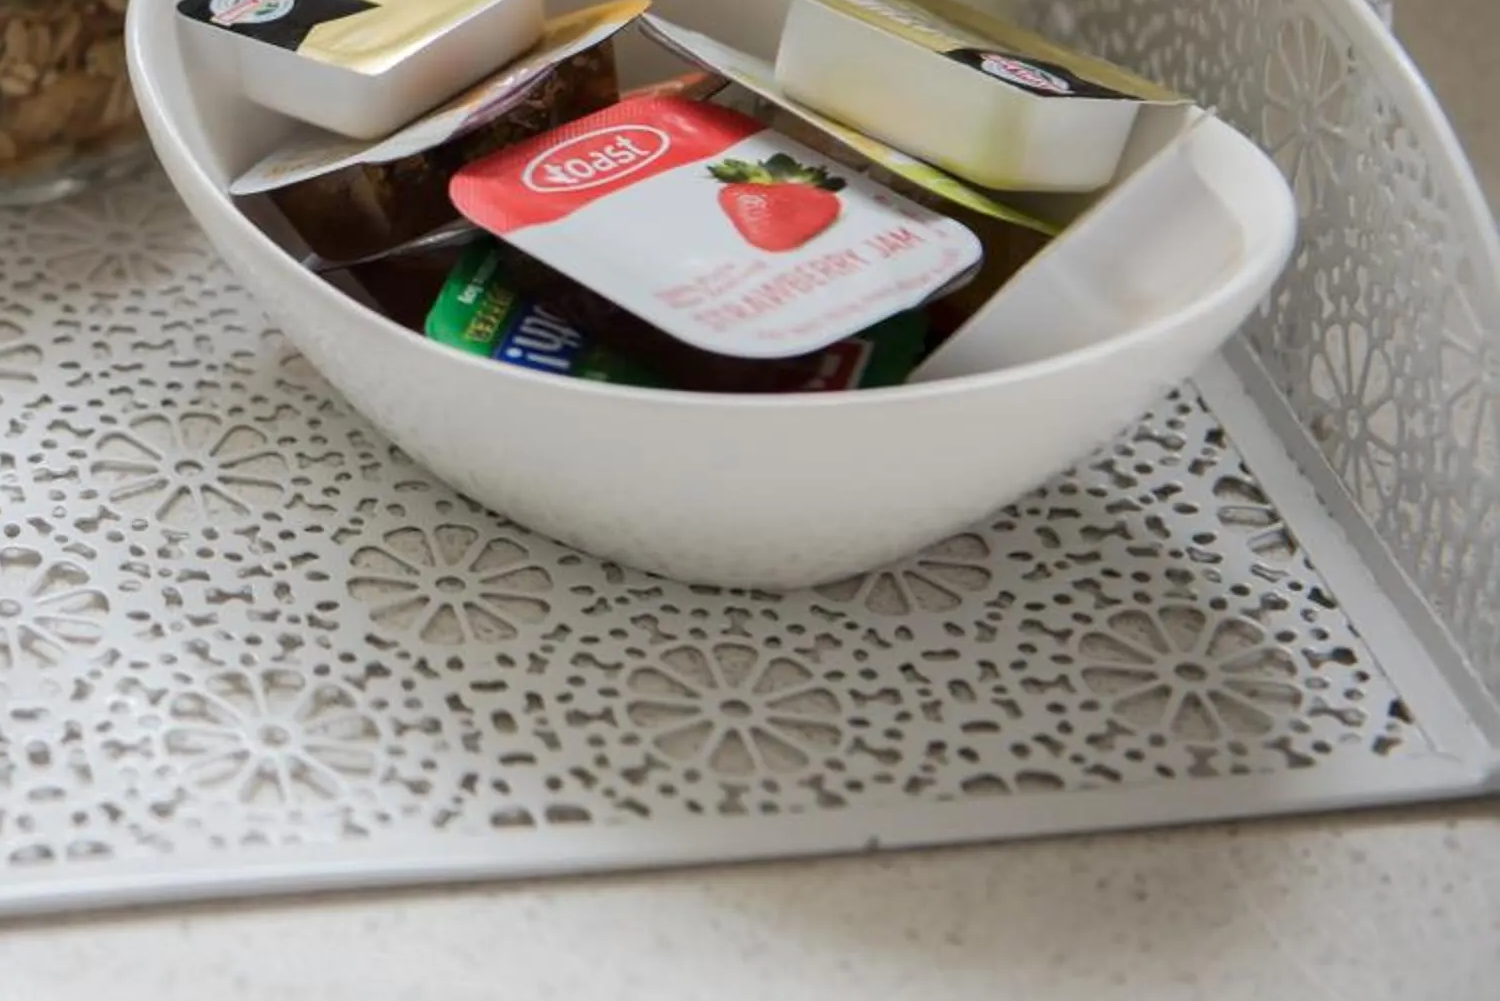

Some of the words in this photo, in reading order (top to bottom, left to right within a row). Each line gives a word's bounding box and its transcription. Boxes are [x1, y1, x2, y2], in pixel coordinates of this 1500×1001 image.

[543, 134, 650, 184] toast
[692, 246, 871, 333] STRAWBERRY
[862, 225, 926, 259] JAM
